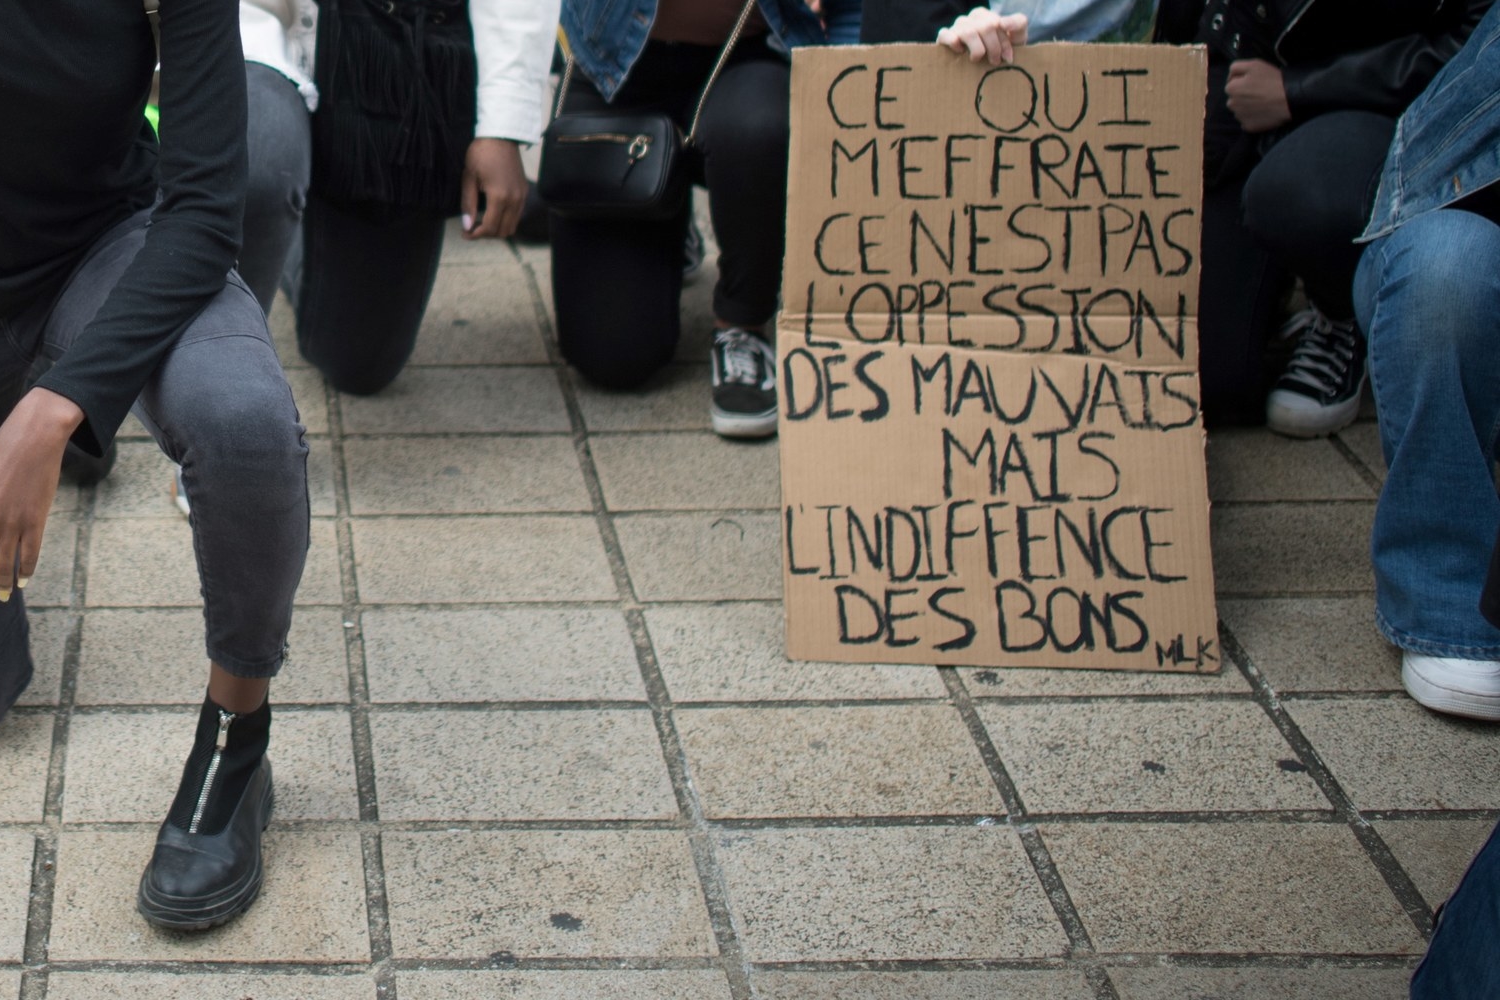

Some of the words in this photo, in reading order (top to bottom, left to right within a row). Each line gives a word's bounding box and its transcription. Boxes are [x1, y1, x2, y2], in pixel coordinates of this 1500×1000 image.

[827, 64, 912, 130] CE
[975, 64, 1151, 133] QUI
[831, 133, 1181, 200] M'EFFRAIE
[814, 212, 890, 277] CE
[910, 204, 1092, 277] N'EST
[1098, 203, 1194, 277] PAS
[805, 280, 1188, 360] L'OPPESSION
[783, 347, 891, 423] DES
[911, 352, 1201, 432] MAUVAIS
[942, 427, 1120, 503] MAIS
[785, 499, 1188, 582] L'INDIFFENCE
[834, 584, 978, 652] DES
[995, 579, 1149, 654] BONS
[1155, 634, 1218, 667] MLK
